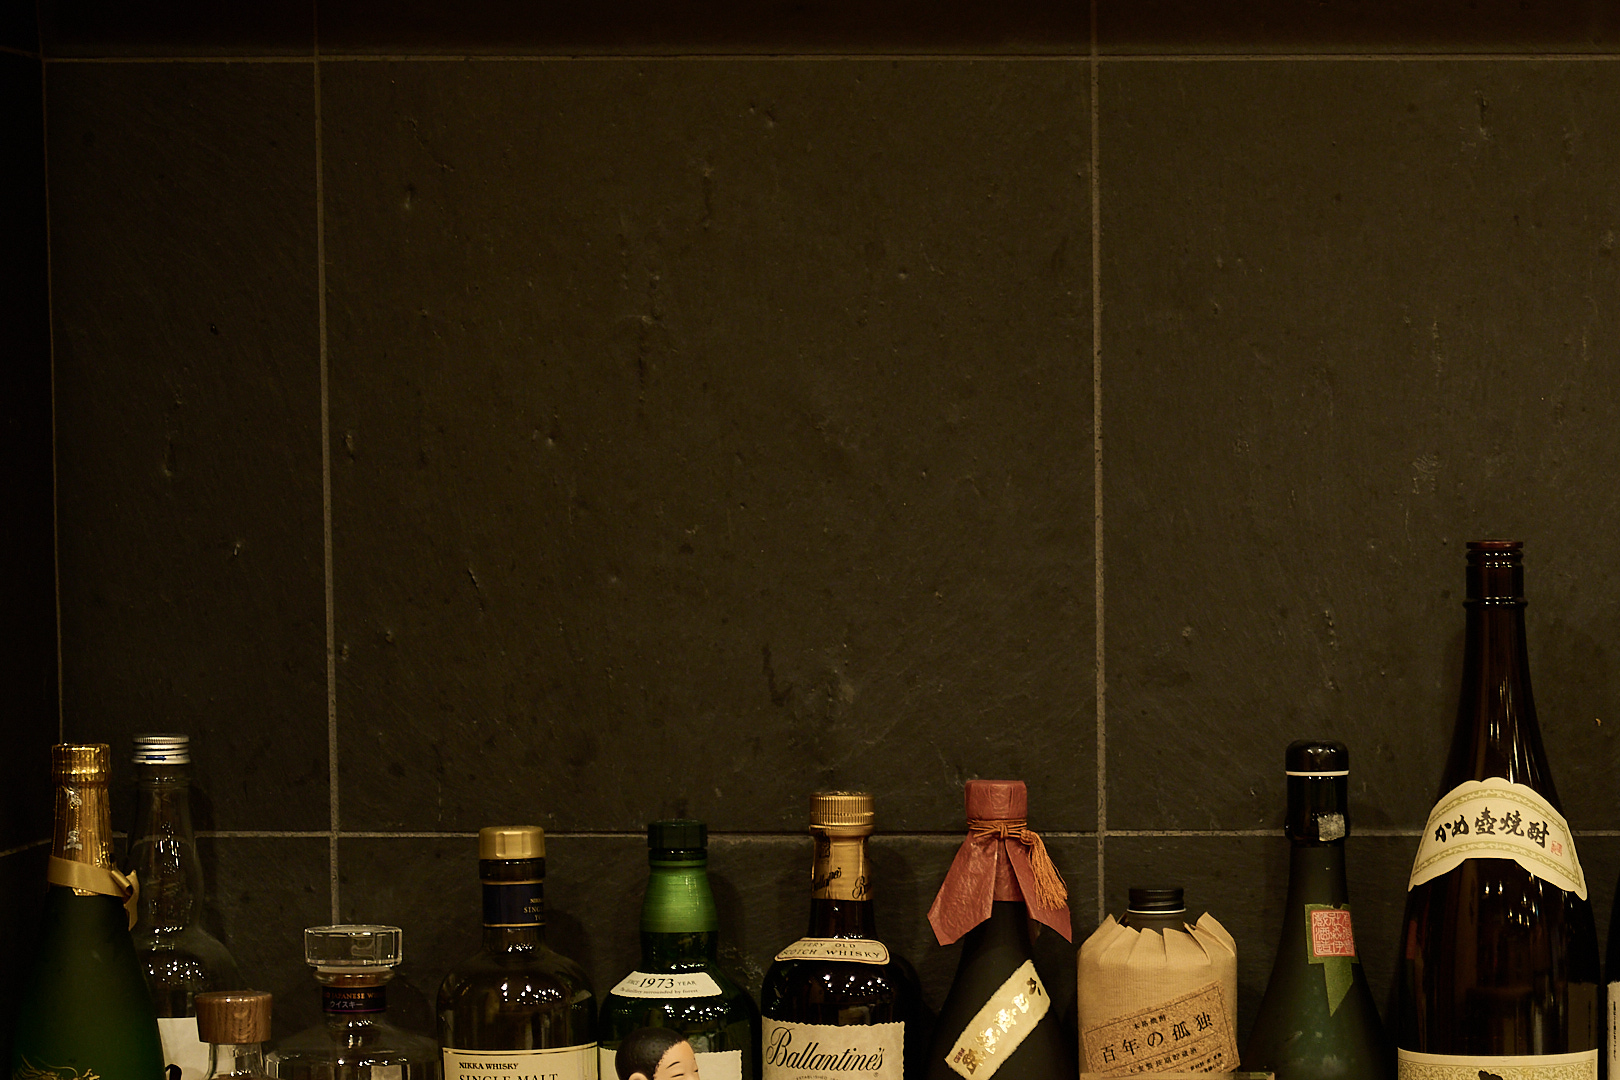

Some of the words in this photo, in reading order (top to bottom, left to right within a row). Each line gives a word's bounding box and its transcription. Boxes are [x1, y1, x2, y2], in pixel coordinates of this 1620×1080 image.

[1433, 806, 1551, 850] かめ壺焼酎
[826, 949, 881, 958] WHISKY
[640, 977, 674, 989] 1973
[329, 1000, 364, 1009] ウイスキー
[1100, 1011, 1213, 1064] 百年の孤独
[765, 1026, 885, 1073] Ballantine's
[459, 1061, 485, 1071] NIKKA
[486, 1061, 519, 1071] WHISKY
